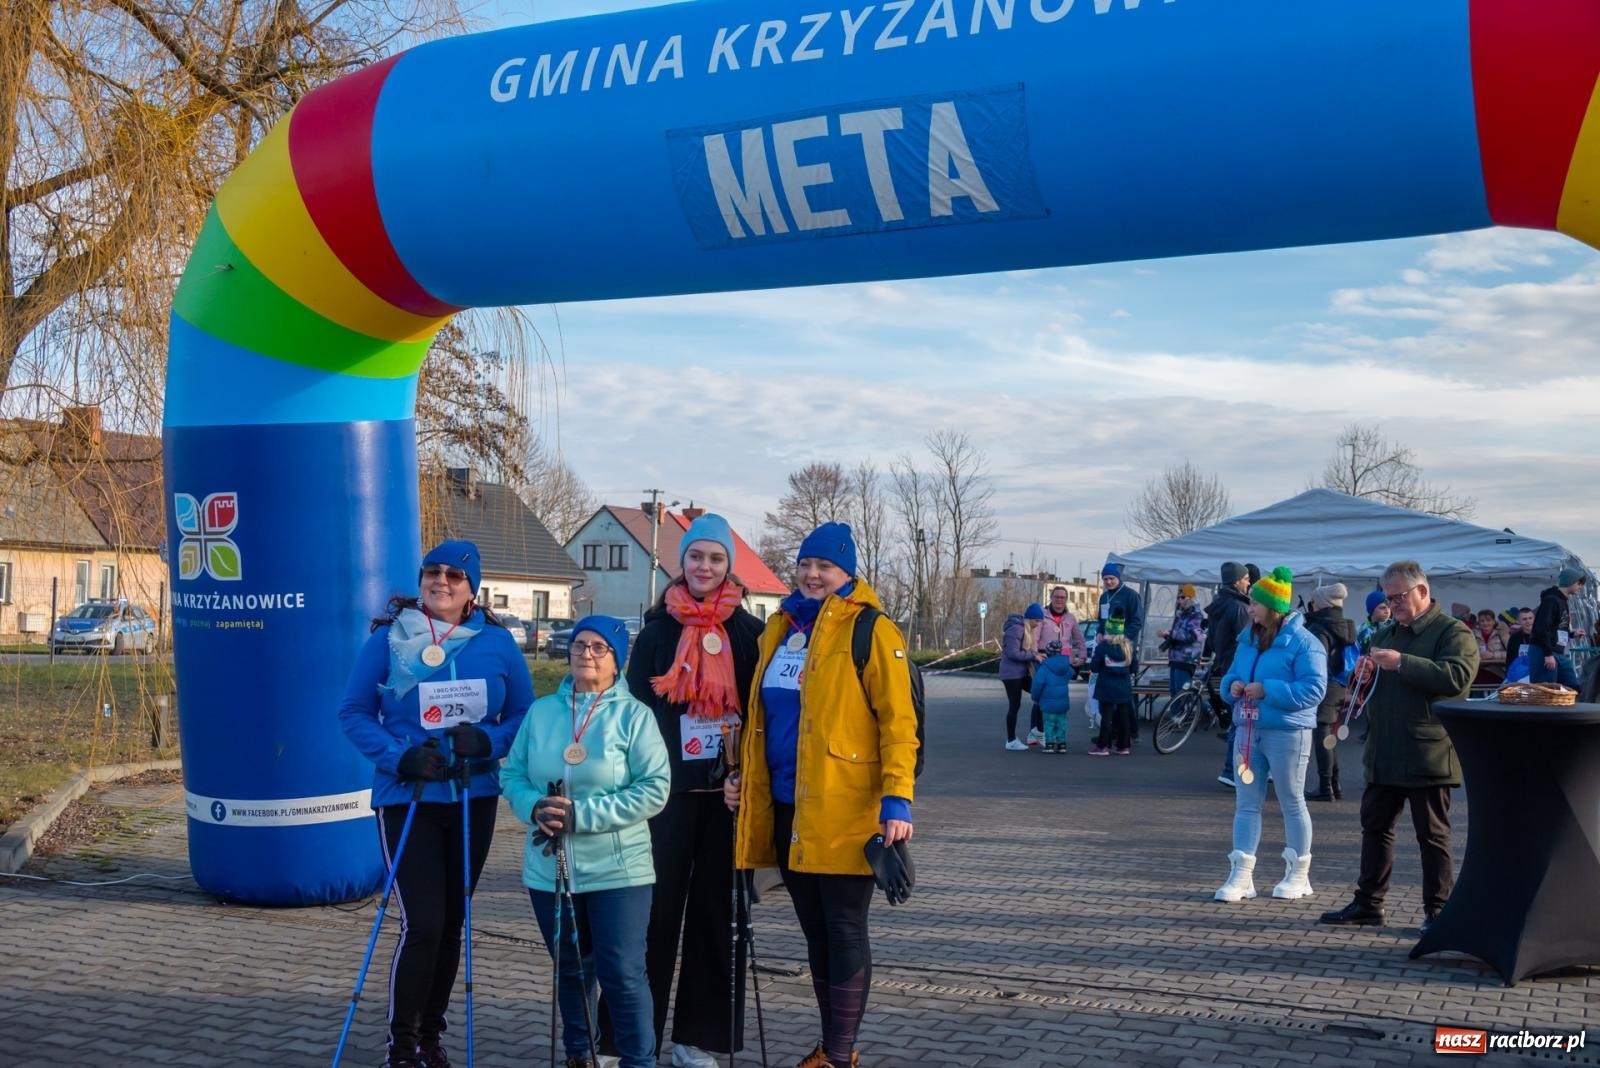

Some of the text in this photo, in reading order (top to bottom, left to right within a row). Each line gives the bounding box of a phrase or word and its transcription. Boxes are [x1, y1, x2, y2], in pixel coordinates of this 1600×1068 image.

[490, 35, 684, 103] GMINA
[703, 101, 1000, 239] META
[183, 591, 305, 610] KRZYŻANOWICE
[216, 619, 264, 630] zapamiętaj
[779, 663, 799, 678] 20
[445, 703, 465, 718] 25
[231, 801, 359, 818] WWW.FACEBOOK.PL/GMINAKRZYZANOWICE
